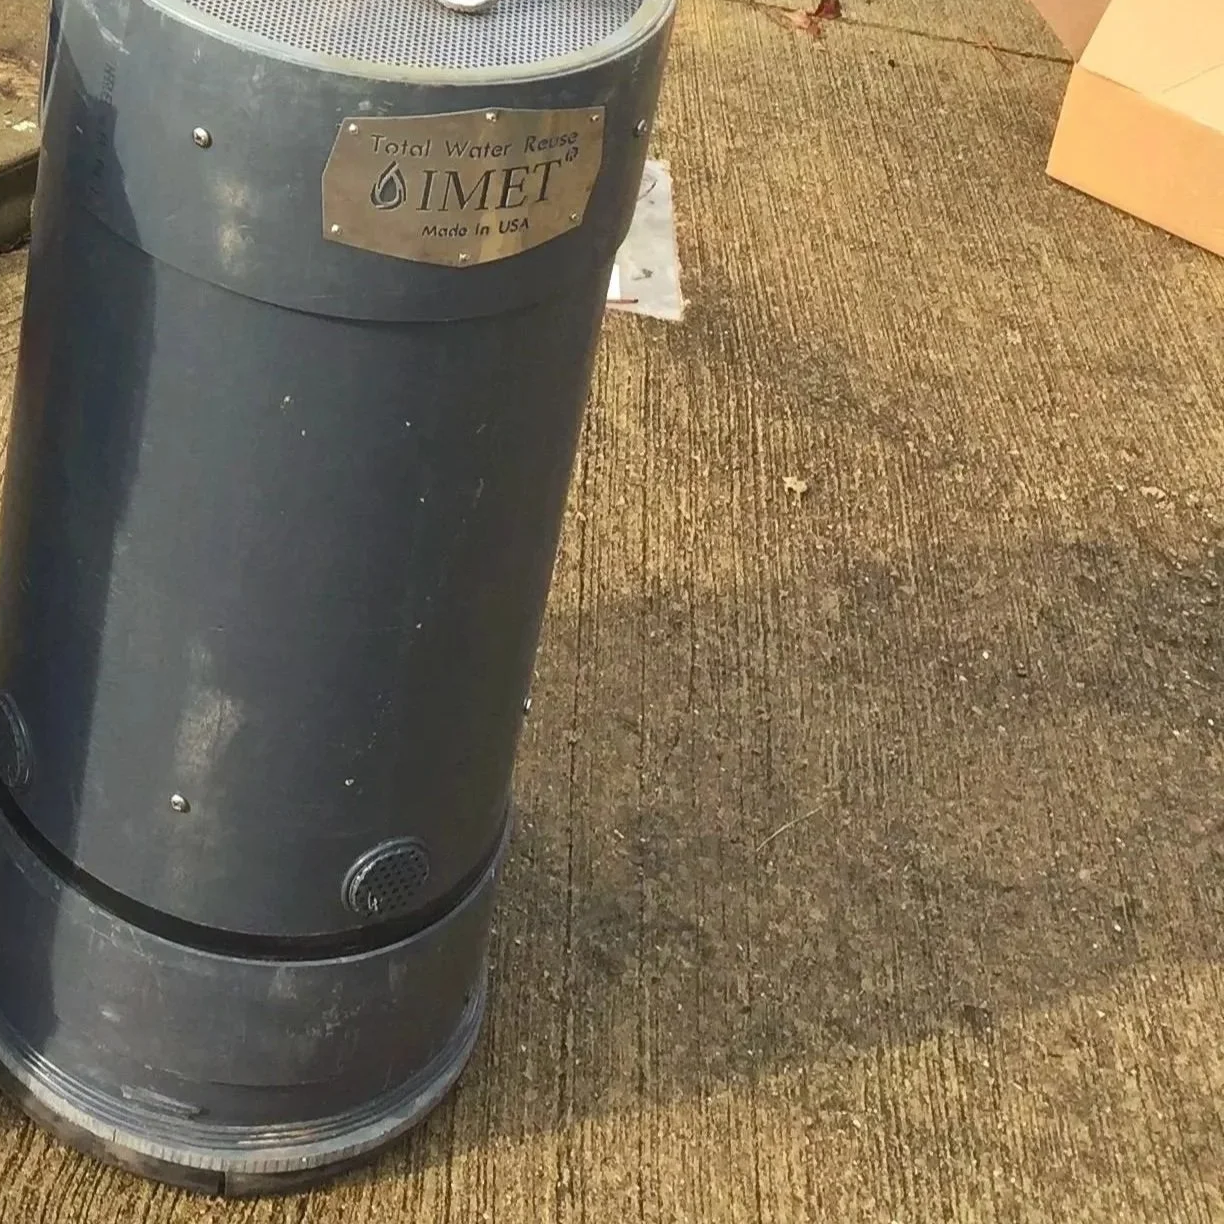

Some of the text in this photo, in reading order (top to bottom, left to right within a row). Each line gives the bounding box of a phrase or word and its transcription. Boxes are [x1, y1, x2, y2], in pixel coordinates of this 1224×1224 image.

[371, 130, 579, 158] Total Water Reuse
[422, 217, 530, 237] Made In USA
